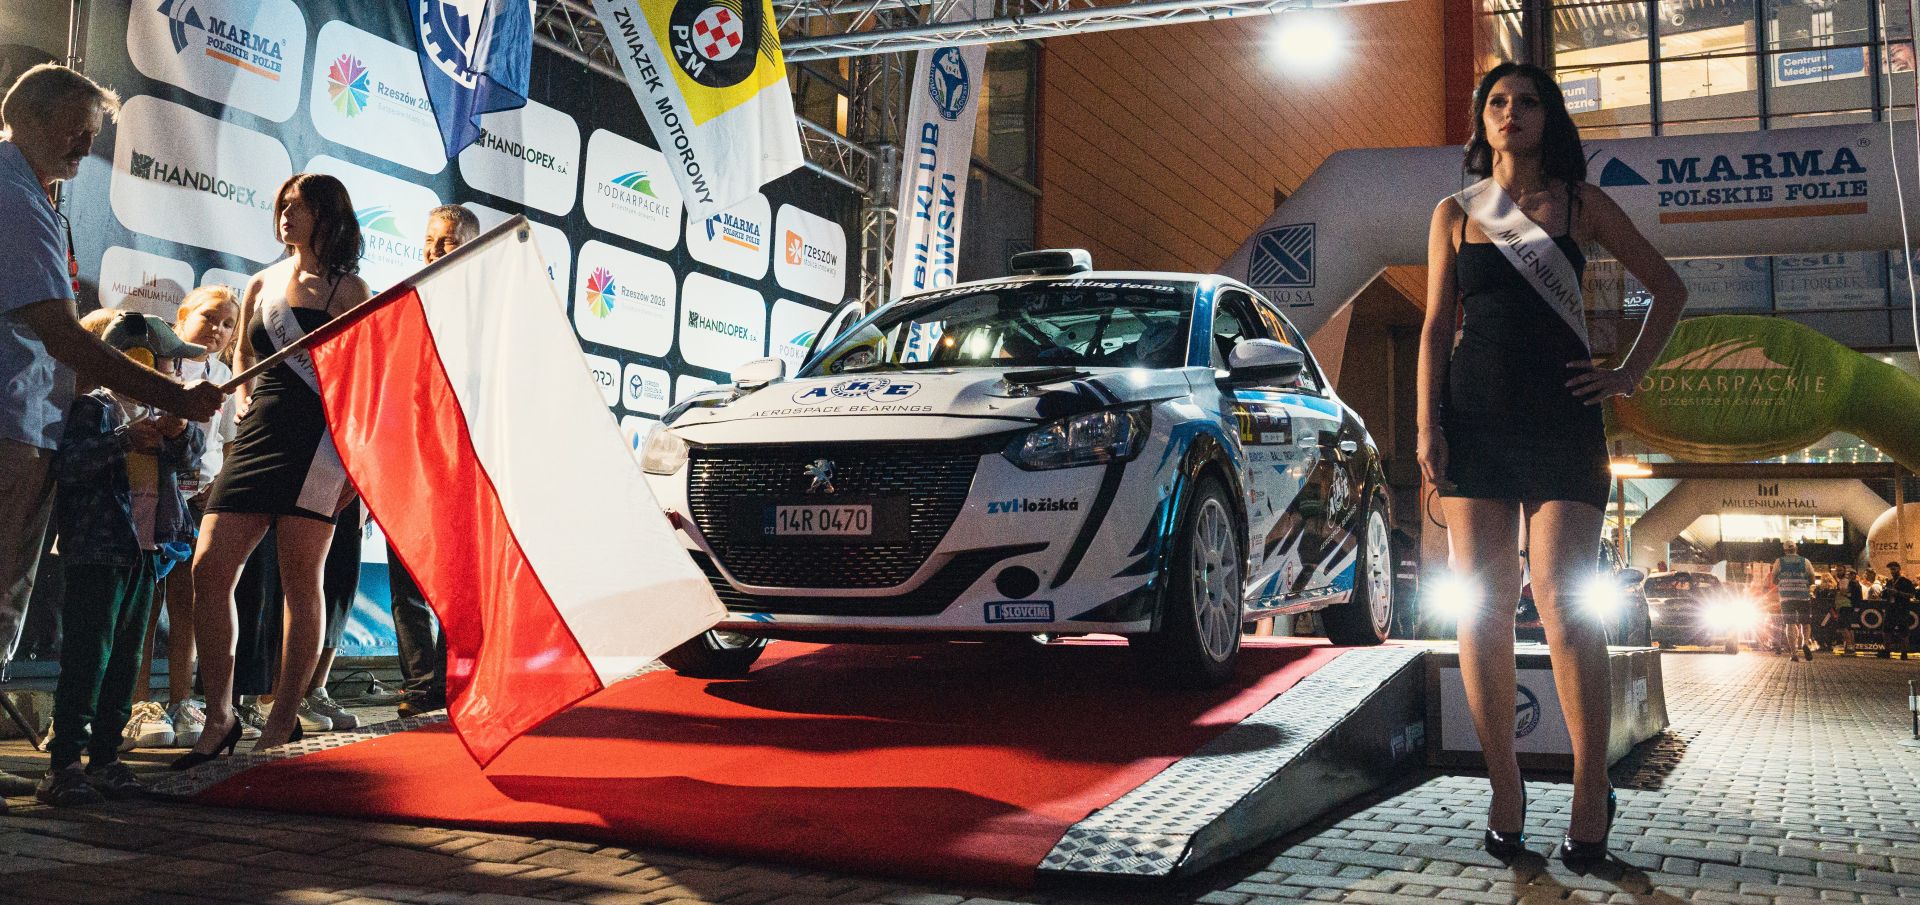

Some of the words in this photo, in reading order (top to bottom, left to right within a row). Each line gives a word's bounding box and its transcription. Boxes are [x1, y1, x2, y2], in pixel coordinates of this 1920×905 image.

[208, 16, 282, 60] MARMA
[613, 7, 664, 94] ZWIĄZEK
[206, 36, 248, 60] POLSKIE
[252, 54, 281, 73] FOLIE
[672, 25, 706, 79] PZM
[1783, 54, 1827, 67] Centrum
[377, 81, 417, 107] Rzeszów
[487, 133, 555, 171] HANDLOPEX
[655, 96, 714, 204] MOTOROWY
[916, 121, 939, 222] KLUB
[1657, 147, 1867, 184] MARMA
[153, 161, 257, 207] HANDLOPEX
[1658, 186, 1774, 207] POLSKIE
[1785, 180, 1868, 201] FOLIE
[597, 182, 670, 218] PODKARPACKIE
[723, 213, 761, 237] MARMA
[804, 243, 838, 266] rzeszów
[621, 285, 649, 302] Rzeszów
[650, 294, 666, 307] 2026
[1296, 290, 1315, 303] S.A.
[699, 316, 748, 340] HANDLOPEX
[751, 405, 842, 417] AEROSPACE
[849, 404, 933, 412] BEARINGS
[987, 496, 1079, 514] zvl-ložiská
[764, 526, 775, 535] CZ
[779, 508, 813, 532] 14R
[819, 508, 869, 532] 0470
